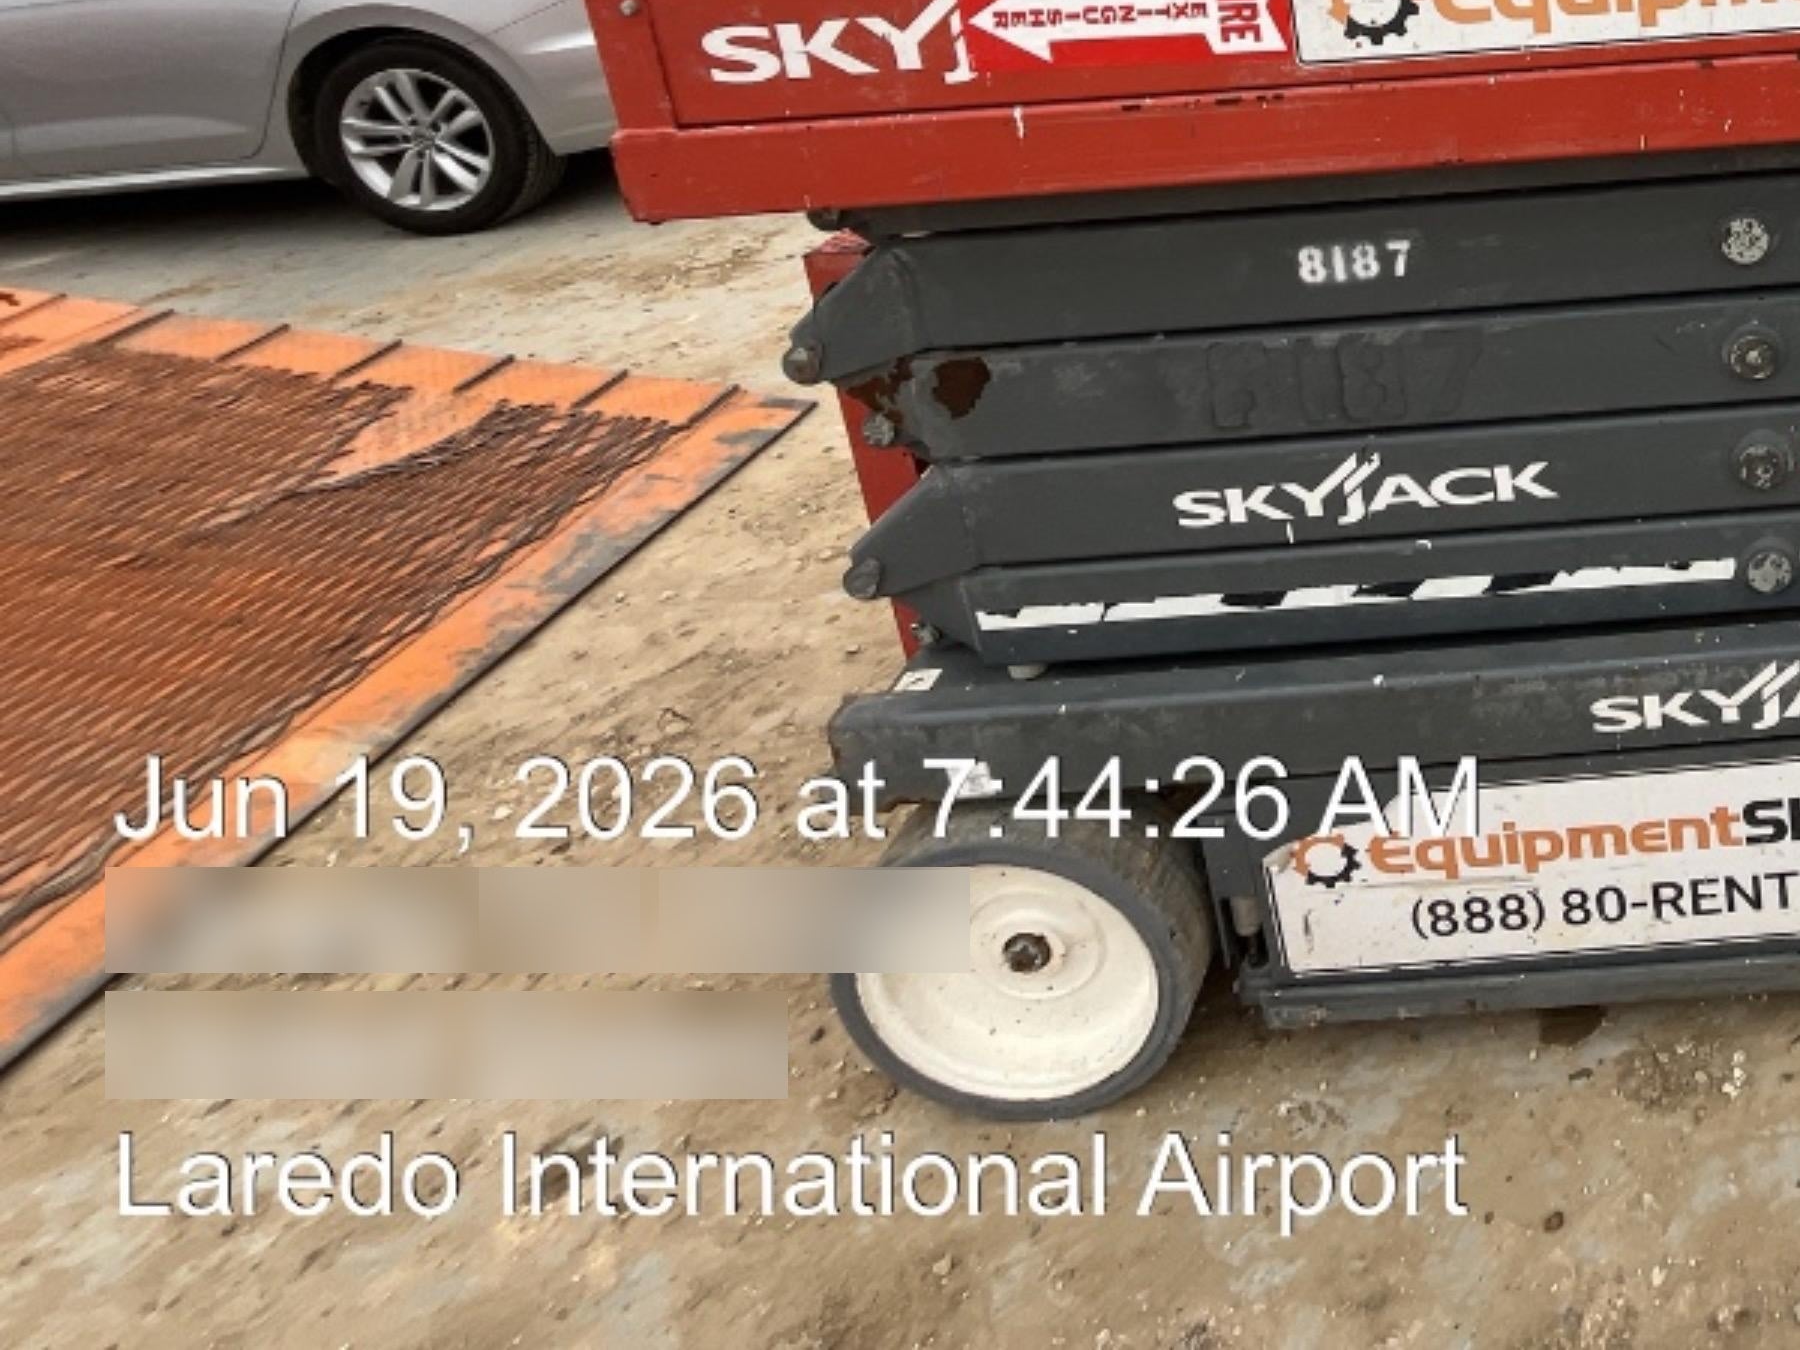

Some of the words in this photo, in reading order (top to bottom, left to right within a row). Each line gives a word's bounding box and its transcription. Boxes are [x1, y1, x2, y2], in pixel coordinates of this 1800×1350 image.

[993, 2, 1208, 30] EXTINGUISHER
[1297, 239, 1412, 285] 8187
[1173, 451, 1560, 529] SKYJACK
[1410, 889, 1546, 940] (888)
